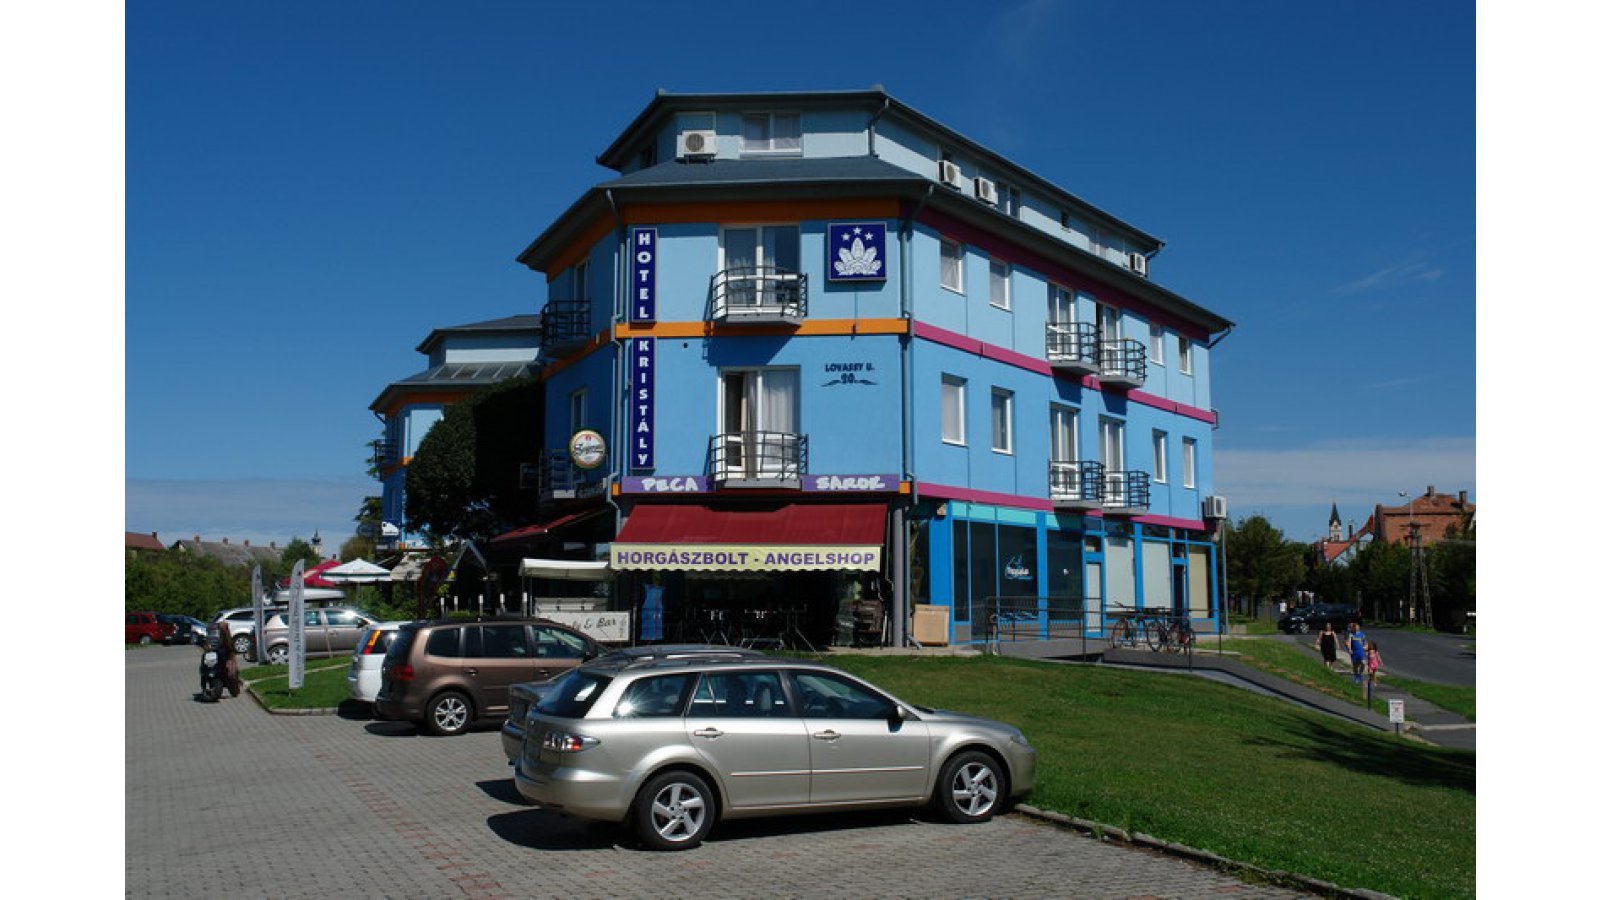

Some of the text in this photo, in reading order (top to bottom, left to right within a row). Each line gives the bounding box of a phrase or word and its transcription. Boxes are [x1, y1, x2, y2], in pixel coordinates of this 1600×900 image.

[636, 232, 652, 319] HOTEL
[636, 340, 651, 466] KRISTÁLY
[641, 477, 698, 492] PECA
[617, 549, 749, 565] HORGÁSZBOLT
[764, 552, 875, 565] ANGELSHOP
